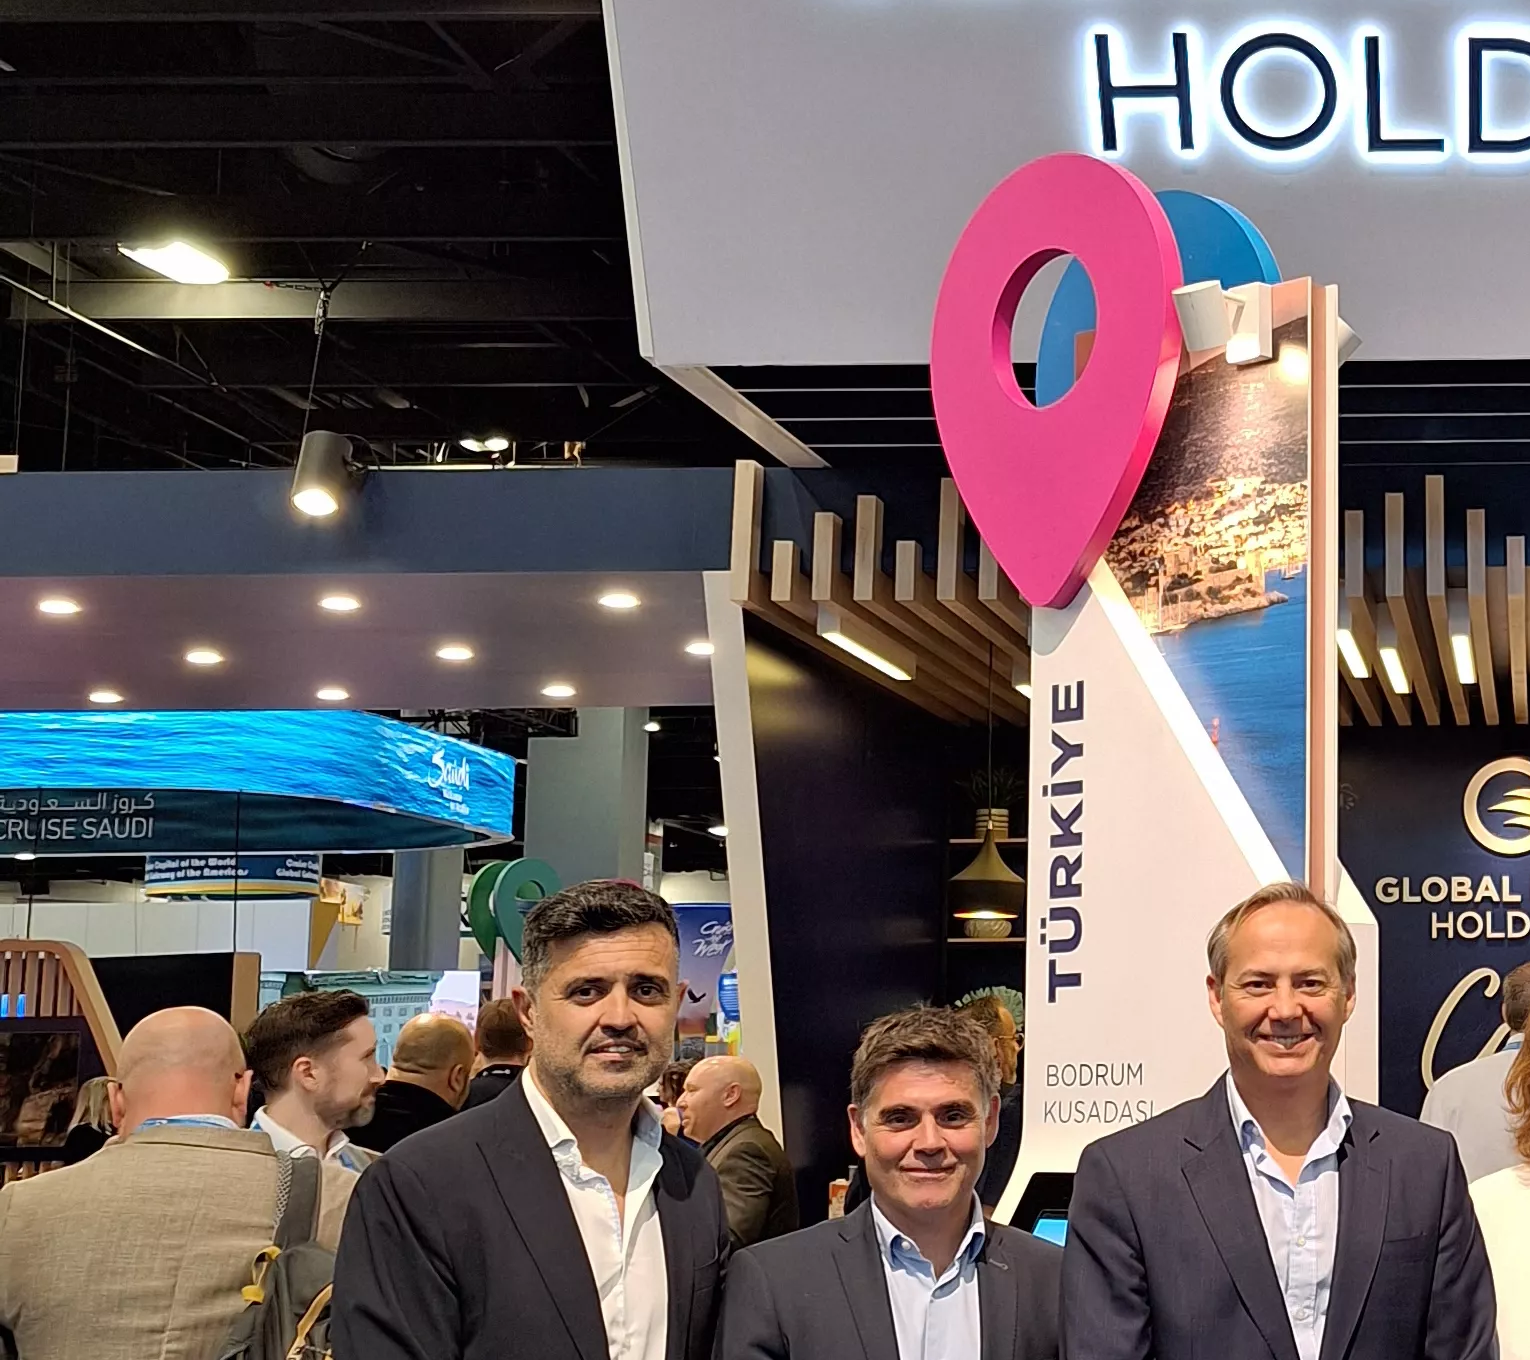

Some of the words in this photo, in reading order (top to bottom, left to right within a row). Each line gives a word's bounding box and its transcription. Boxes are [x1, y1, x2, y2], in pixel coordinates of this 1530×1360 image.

[111, 792, 155, 814] كروز
[81, 817, 153, 839] SAUDI
[1040, 680, 1084, 1003] TÜRKİYE
[1375, 876, 1522, 903] GLOBAL
[1046, 1062, 1143, 1086] BODRUM
[1044, 1100, 1153, 1123] KUSADASI
